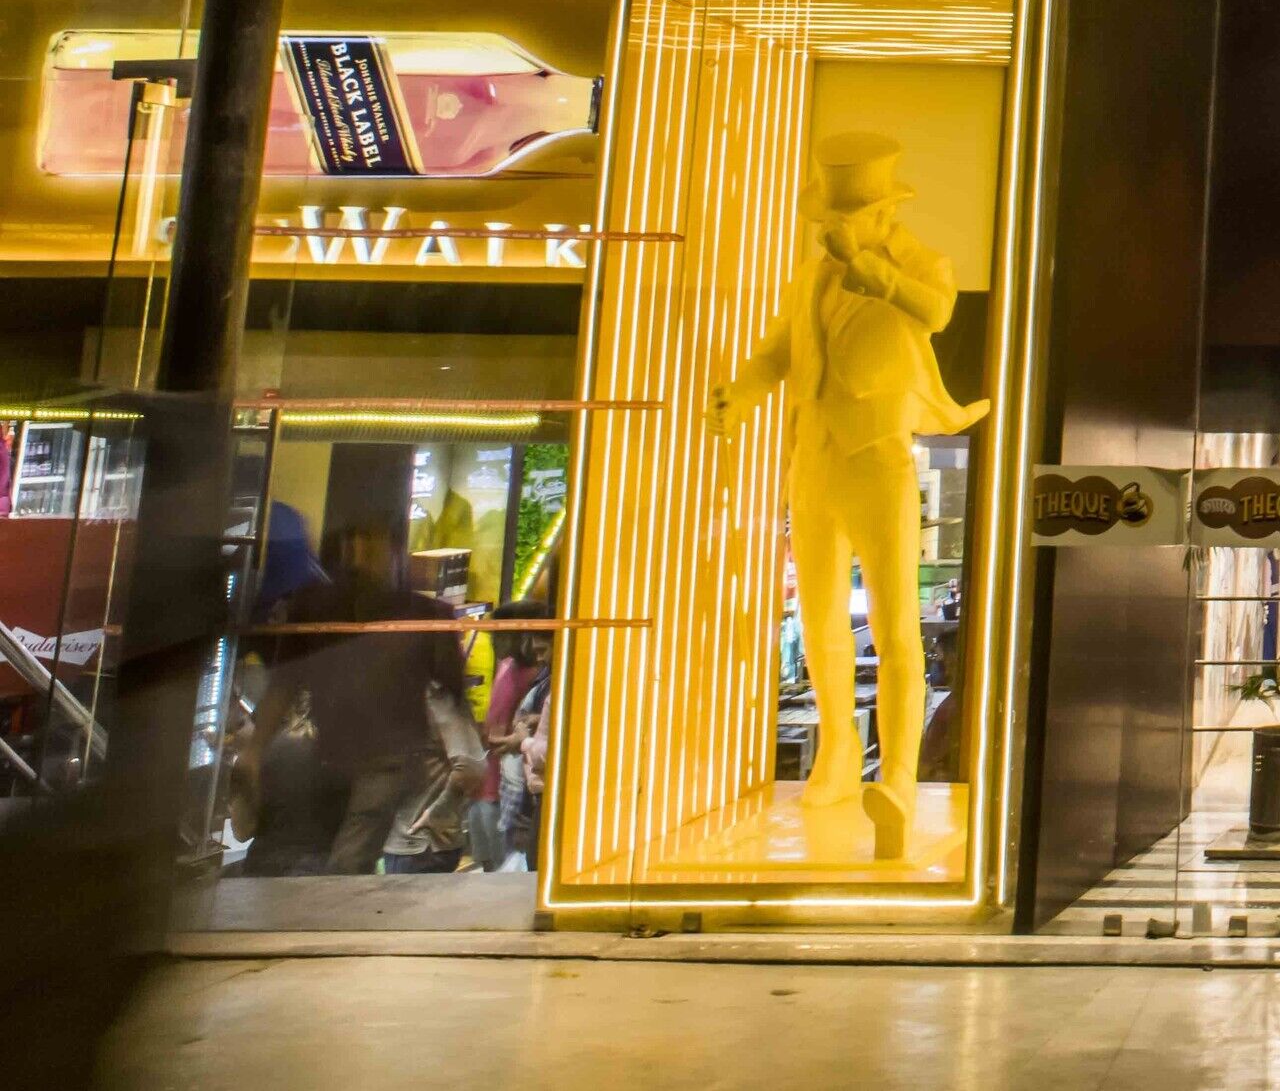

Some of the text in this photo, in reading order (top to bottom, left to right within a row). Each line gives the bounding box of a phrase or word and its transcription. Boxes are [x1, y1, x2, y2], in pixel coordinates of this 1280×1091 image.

[330, 41, 383, 168] BLACK LABEL
[1034, 491, 1112, 521] THEQUE
